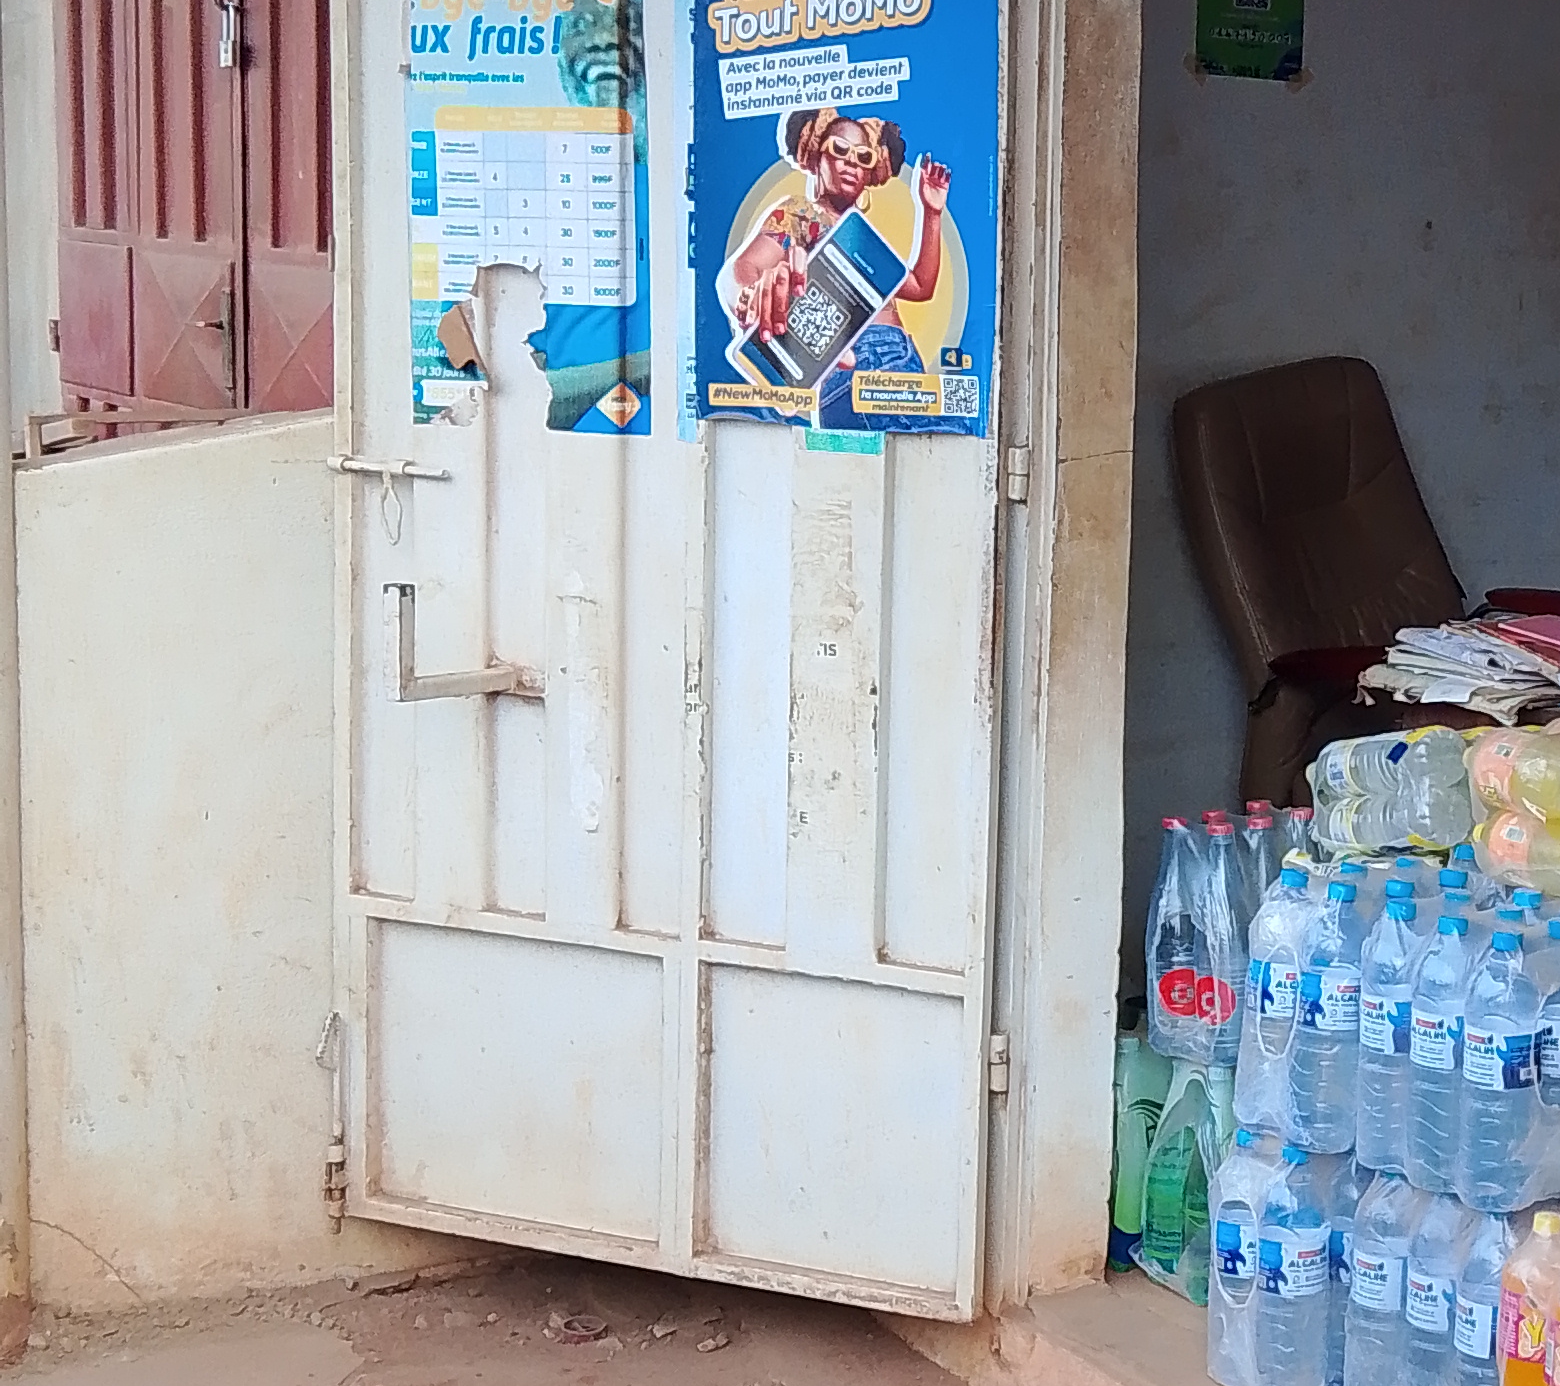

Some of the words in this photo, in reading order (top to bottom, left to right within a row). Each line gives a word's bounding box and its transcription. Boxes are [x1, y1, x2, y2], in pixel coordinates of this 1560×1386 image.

[410, 24, 452, 54] ux
[726, 56, 760, 75] Avec
[762, 56, 776, 72] la
[779, 49, 841, 69] nouvelle
[725, 80, 752, 96] app
[755, 73, 801, 92] MoMo,
[802, 69, 844, 90] payer
[848, 61, 906, 80] devient
[727, 88, 803, 112] instantané
[805, 88, 827, 104] via
[830, 84, 853, 101] QR
[856, 81, 893, 97] code
[858, 374, 923, 390] Télécharge
[712, 386, 813, 408] #NewMoMoApp
[872, 402, 930, 412] maintenant
[873, 391, 914, 401] nouvelle
[915, 392, 936, 403] App
